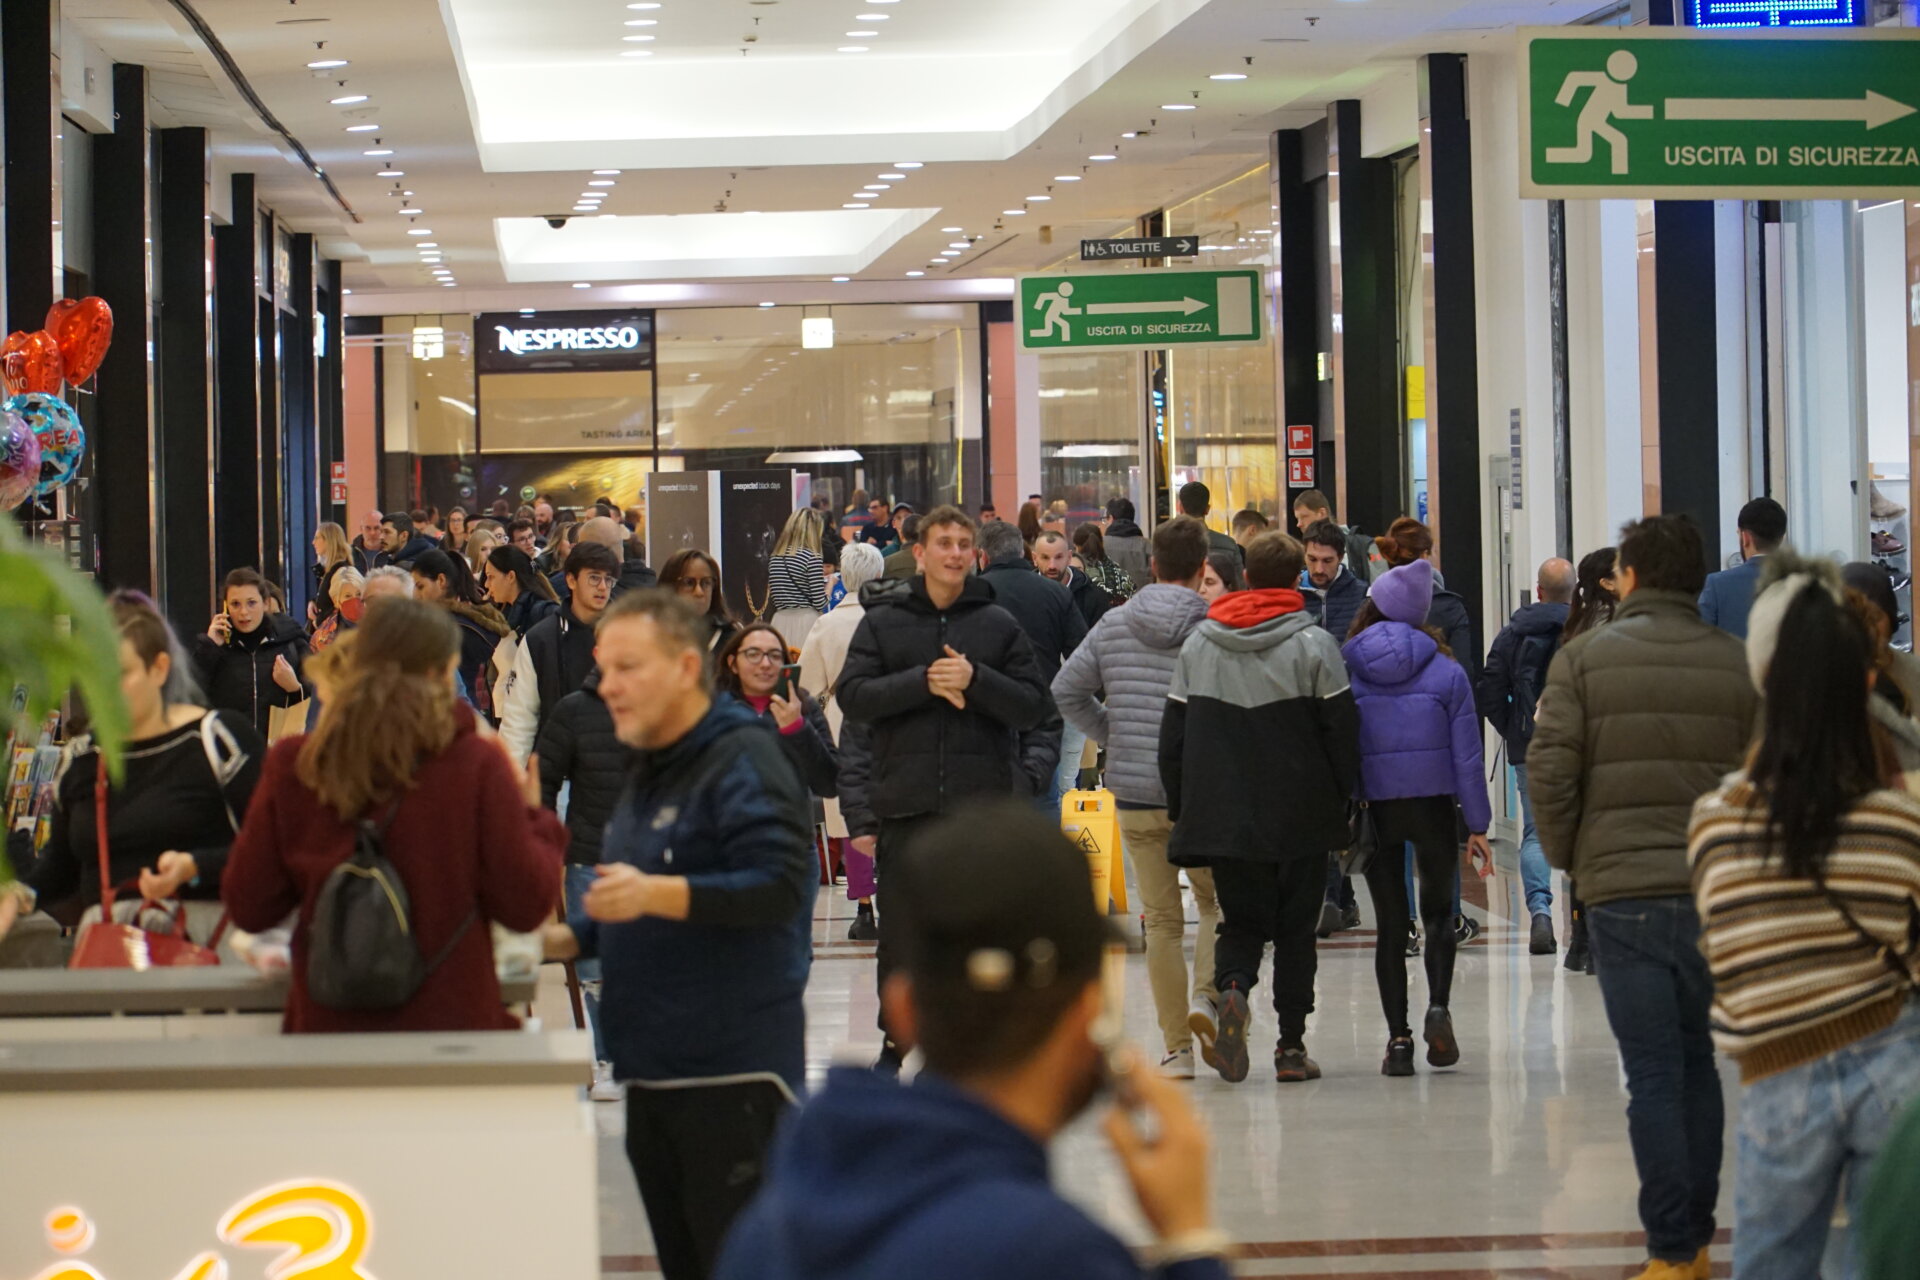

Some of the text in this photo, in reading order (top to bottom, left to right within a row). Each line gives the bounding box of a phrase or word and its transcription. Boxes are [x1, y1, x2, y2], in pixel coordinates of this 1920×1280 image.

[1664, 146, 1920, 166] USCITA DI SICUREZZA
[1109, 242, 1161, 254] TOILETTE
[1087, 323, 1212, 336] USCITA DI SICUREZZA
[494, 325, 639, 355] NESPRESSO
[36, 429, 80, 451] REA
[580, 430, 652, 439] TASTING AREA
